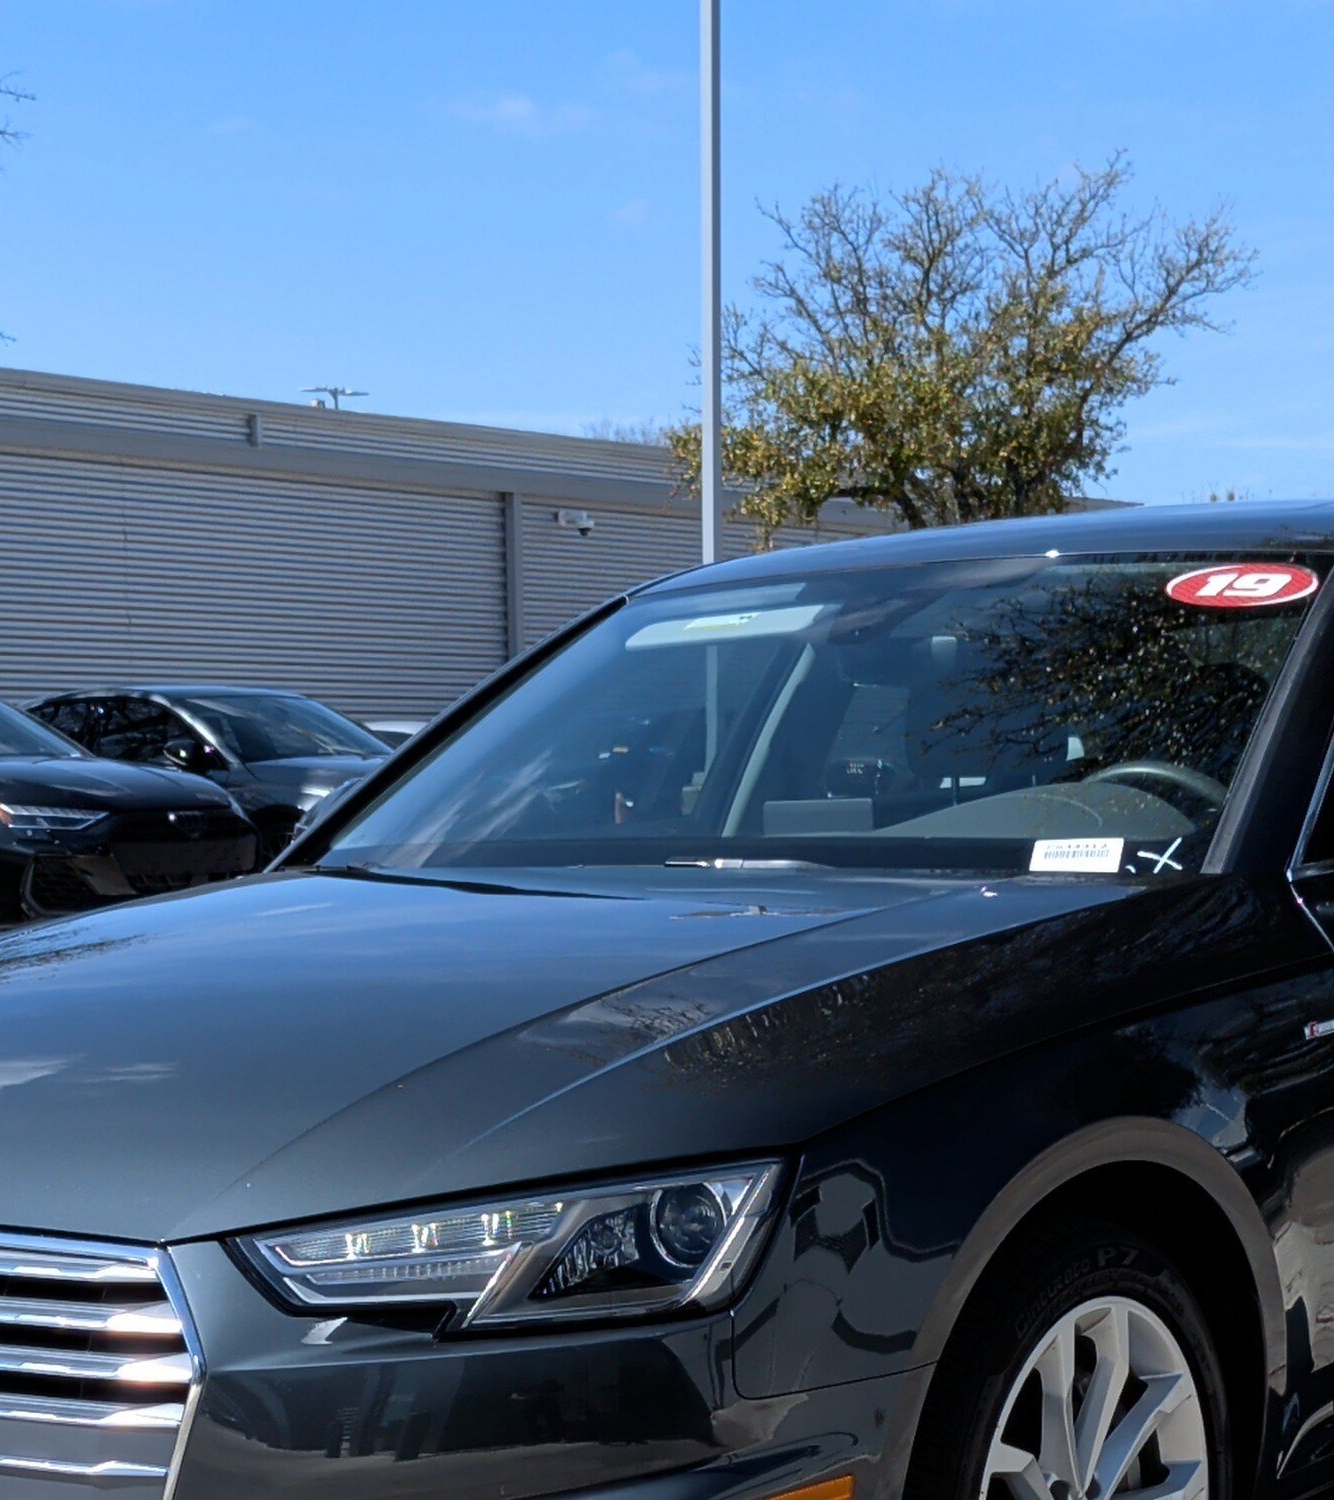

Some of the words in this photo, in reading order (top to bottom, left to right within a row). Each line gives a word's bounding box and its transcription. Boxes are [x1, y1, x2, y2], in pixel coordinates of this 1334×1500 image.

[1195, 573, 1293, 597] 19
[1014, 1258, 1091, 1340] Cinturato
[1096, 1246, 1139, 1267] P7
